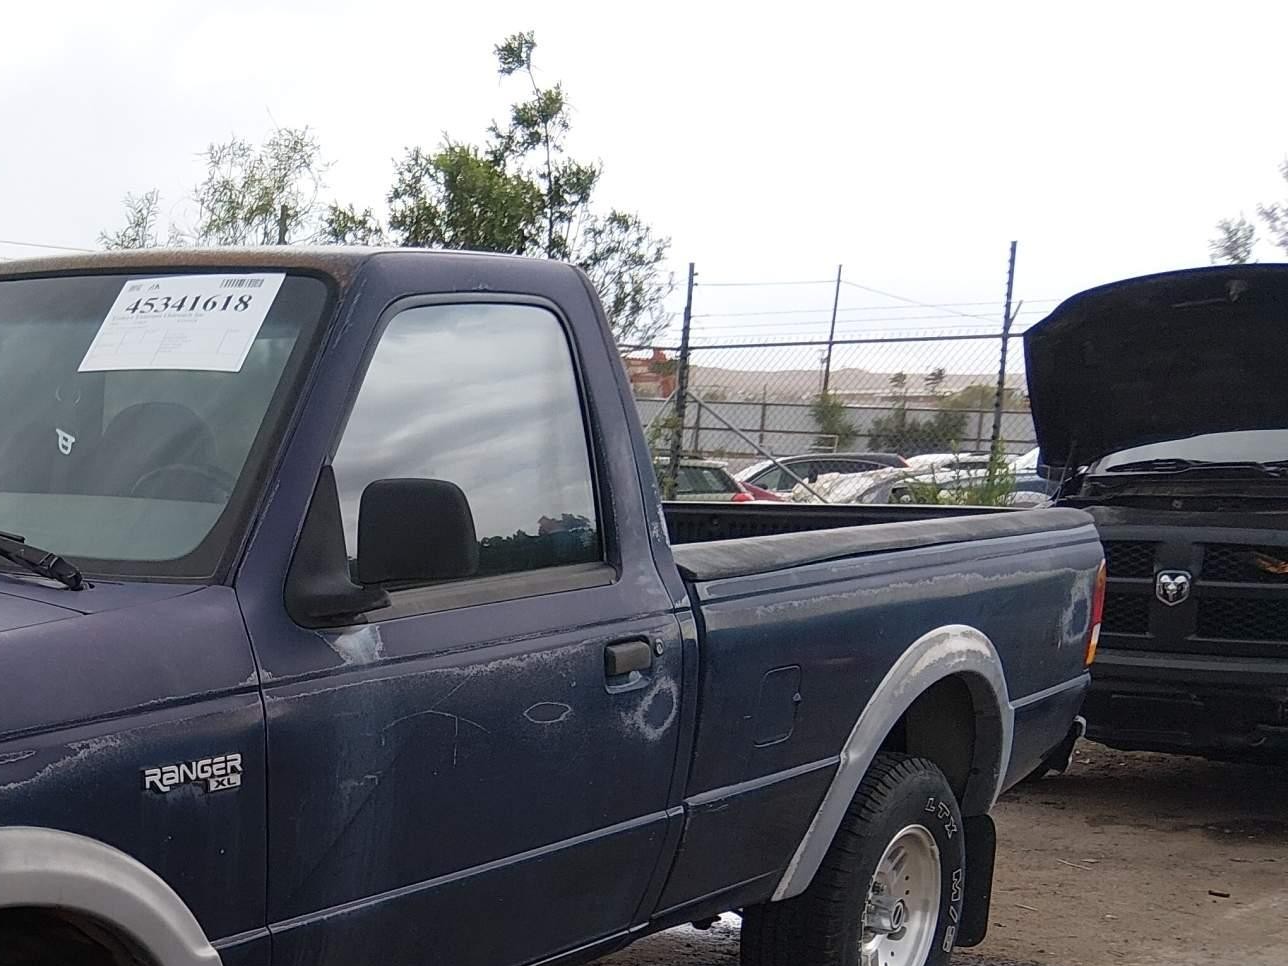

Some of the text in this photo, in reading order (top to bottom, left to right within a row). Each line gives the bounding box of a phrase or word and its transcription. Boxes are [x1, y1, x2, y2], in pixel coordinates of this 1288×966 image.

[125, 293, 253, 314] 45341618
[214, 778, 237, 789] XL
[924, 797, 958, 839] LTX
